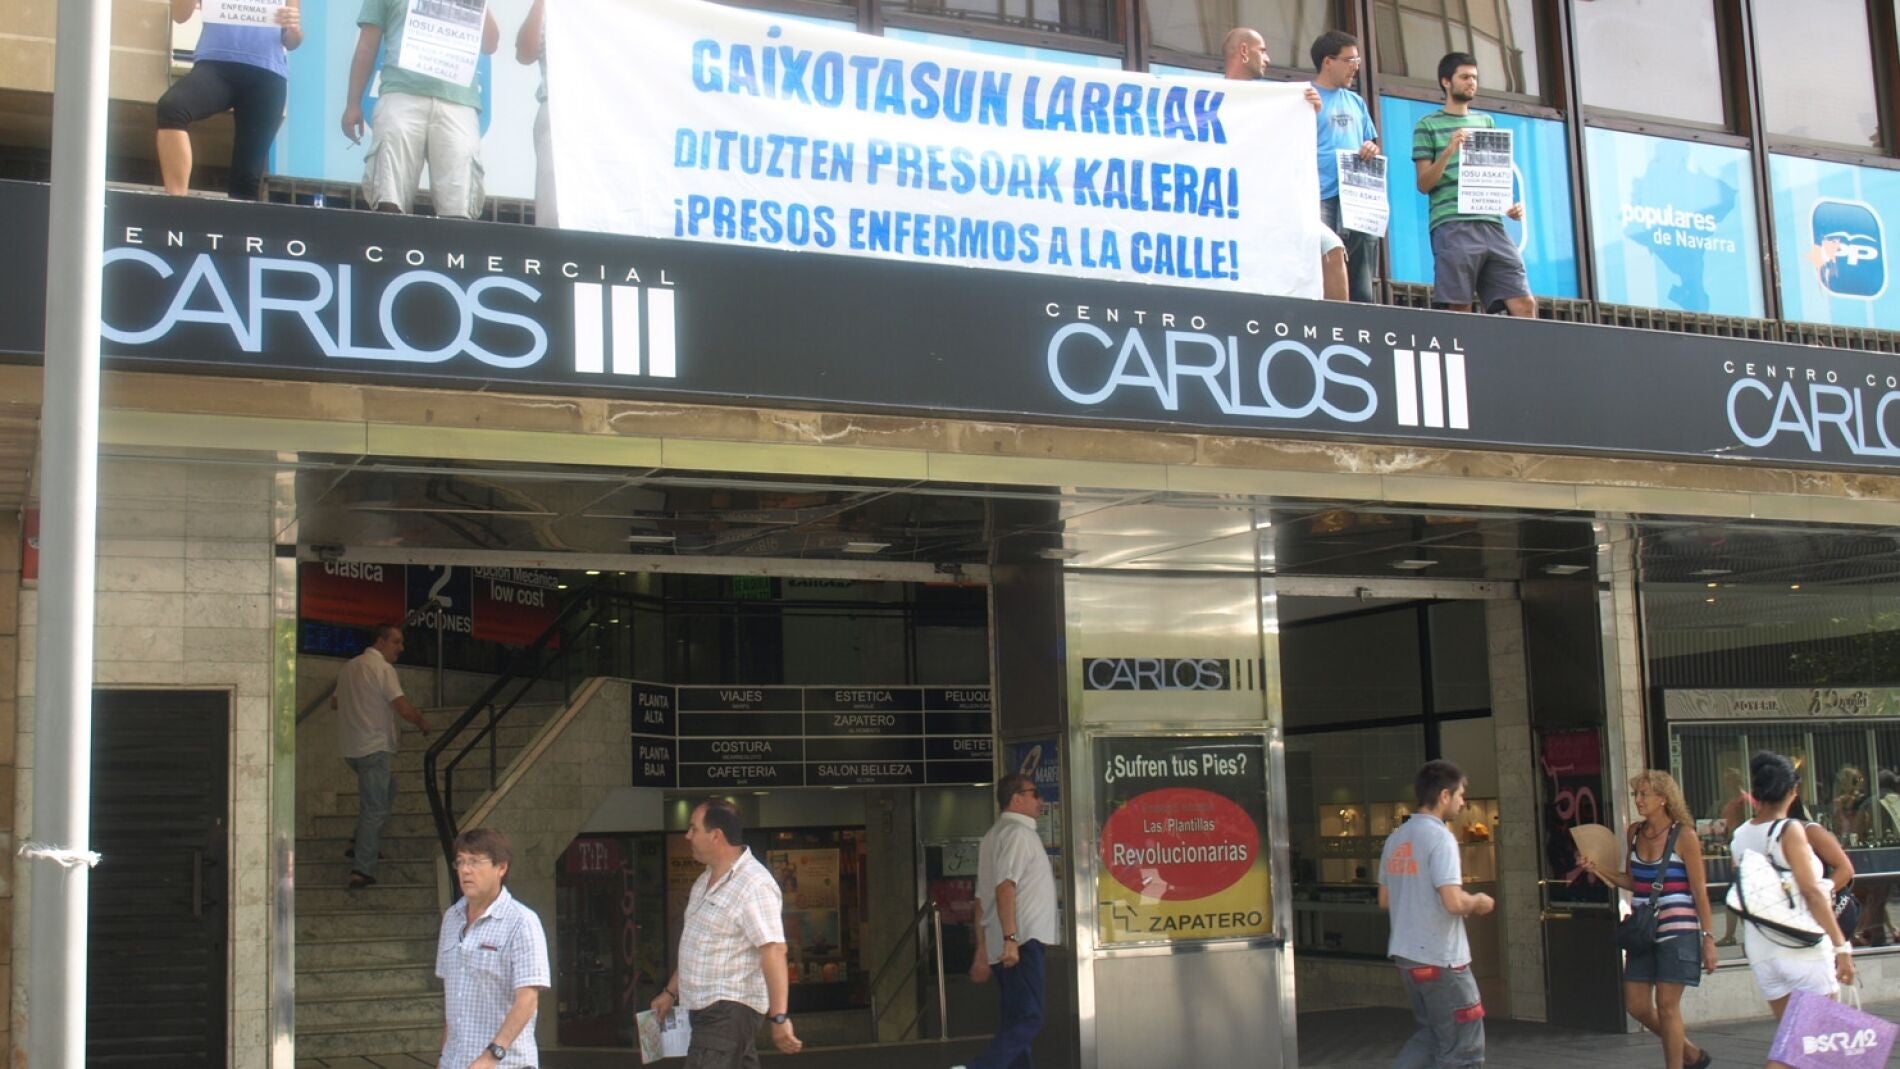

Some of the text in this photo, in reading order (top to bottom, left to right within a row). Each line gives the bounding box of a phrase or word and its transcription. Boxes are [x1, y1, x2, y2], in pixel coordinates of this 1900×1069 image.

[408, 18, 435, 33] IOSU
[437, 26, 480, 43] ASKATU
[1022, 75, 1228, 145] LARRIAK
[673, 127, 1240, 219] DITUZTEN PRESOAK KALERA!
[1620, 202, 1717, 232] populares
[849, 207, 1040, 264] ENFERMOS
[1047, 225, 1073, 267] A
[1079, 227, 1122, 270] LA
[1130, 231, 1240, 281] CALLE!
[1653, 227, 1736, 253] de Navarra
[126, 226, 675, 285] ENTRO COMERCIAL
[100, 246, 549, 369] CARLOS
[1045, 302, 1465, 352] CENTRO COMERCIAL
[1046, 321, 1469, 430] CARLOS III
[1723, 360, 1838, 384] CENTRO
[428, 565, 453, 608] 2
[491, 579, 545, 608] low cost
[408, 608, 471, 633] OPCIONES
[1088, 658, 1223, 691] CARLOS
[638, 691, 670, 710] PLANTA
[719, 690, 763, 703] VIAJES
[834, 690, 893, 703] ESTETICA
[643, 710, 665, 725] ALTA
[833, 714, 896, 728] ZAPATERO
[639, 745, 670, 762] PLANTA
[710, 740, 773, 753] COSTURA
[643, 762, 666, 777] BAJA
[706, 765, 778, 779] CAFETERIA
[817, 763, 913, 777] SALON BELLEZA
[1104, 752, 1248, 784] ¿Sufren tus Pies?
[1143, 816, 1217, 834] Las Plantillas
[1112, 840, 1248, 866] Revolucionarias
[1149, 910, 1263, 933] ZAPATERO
